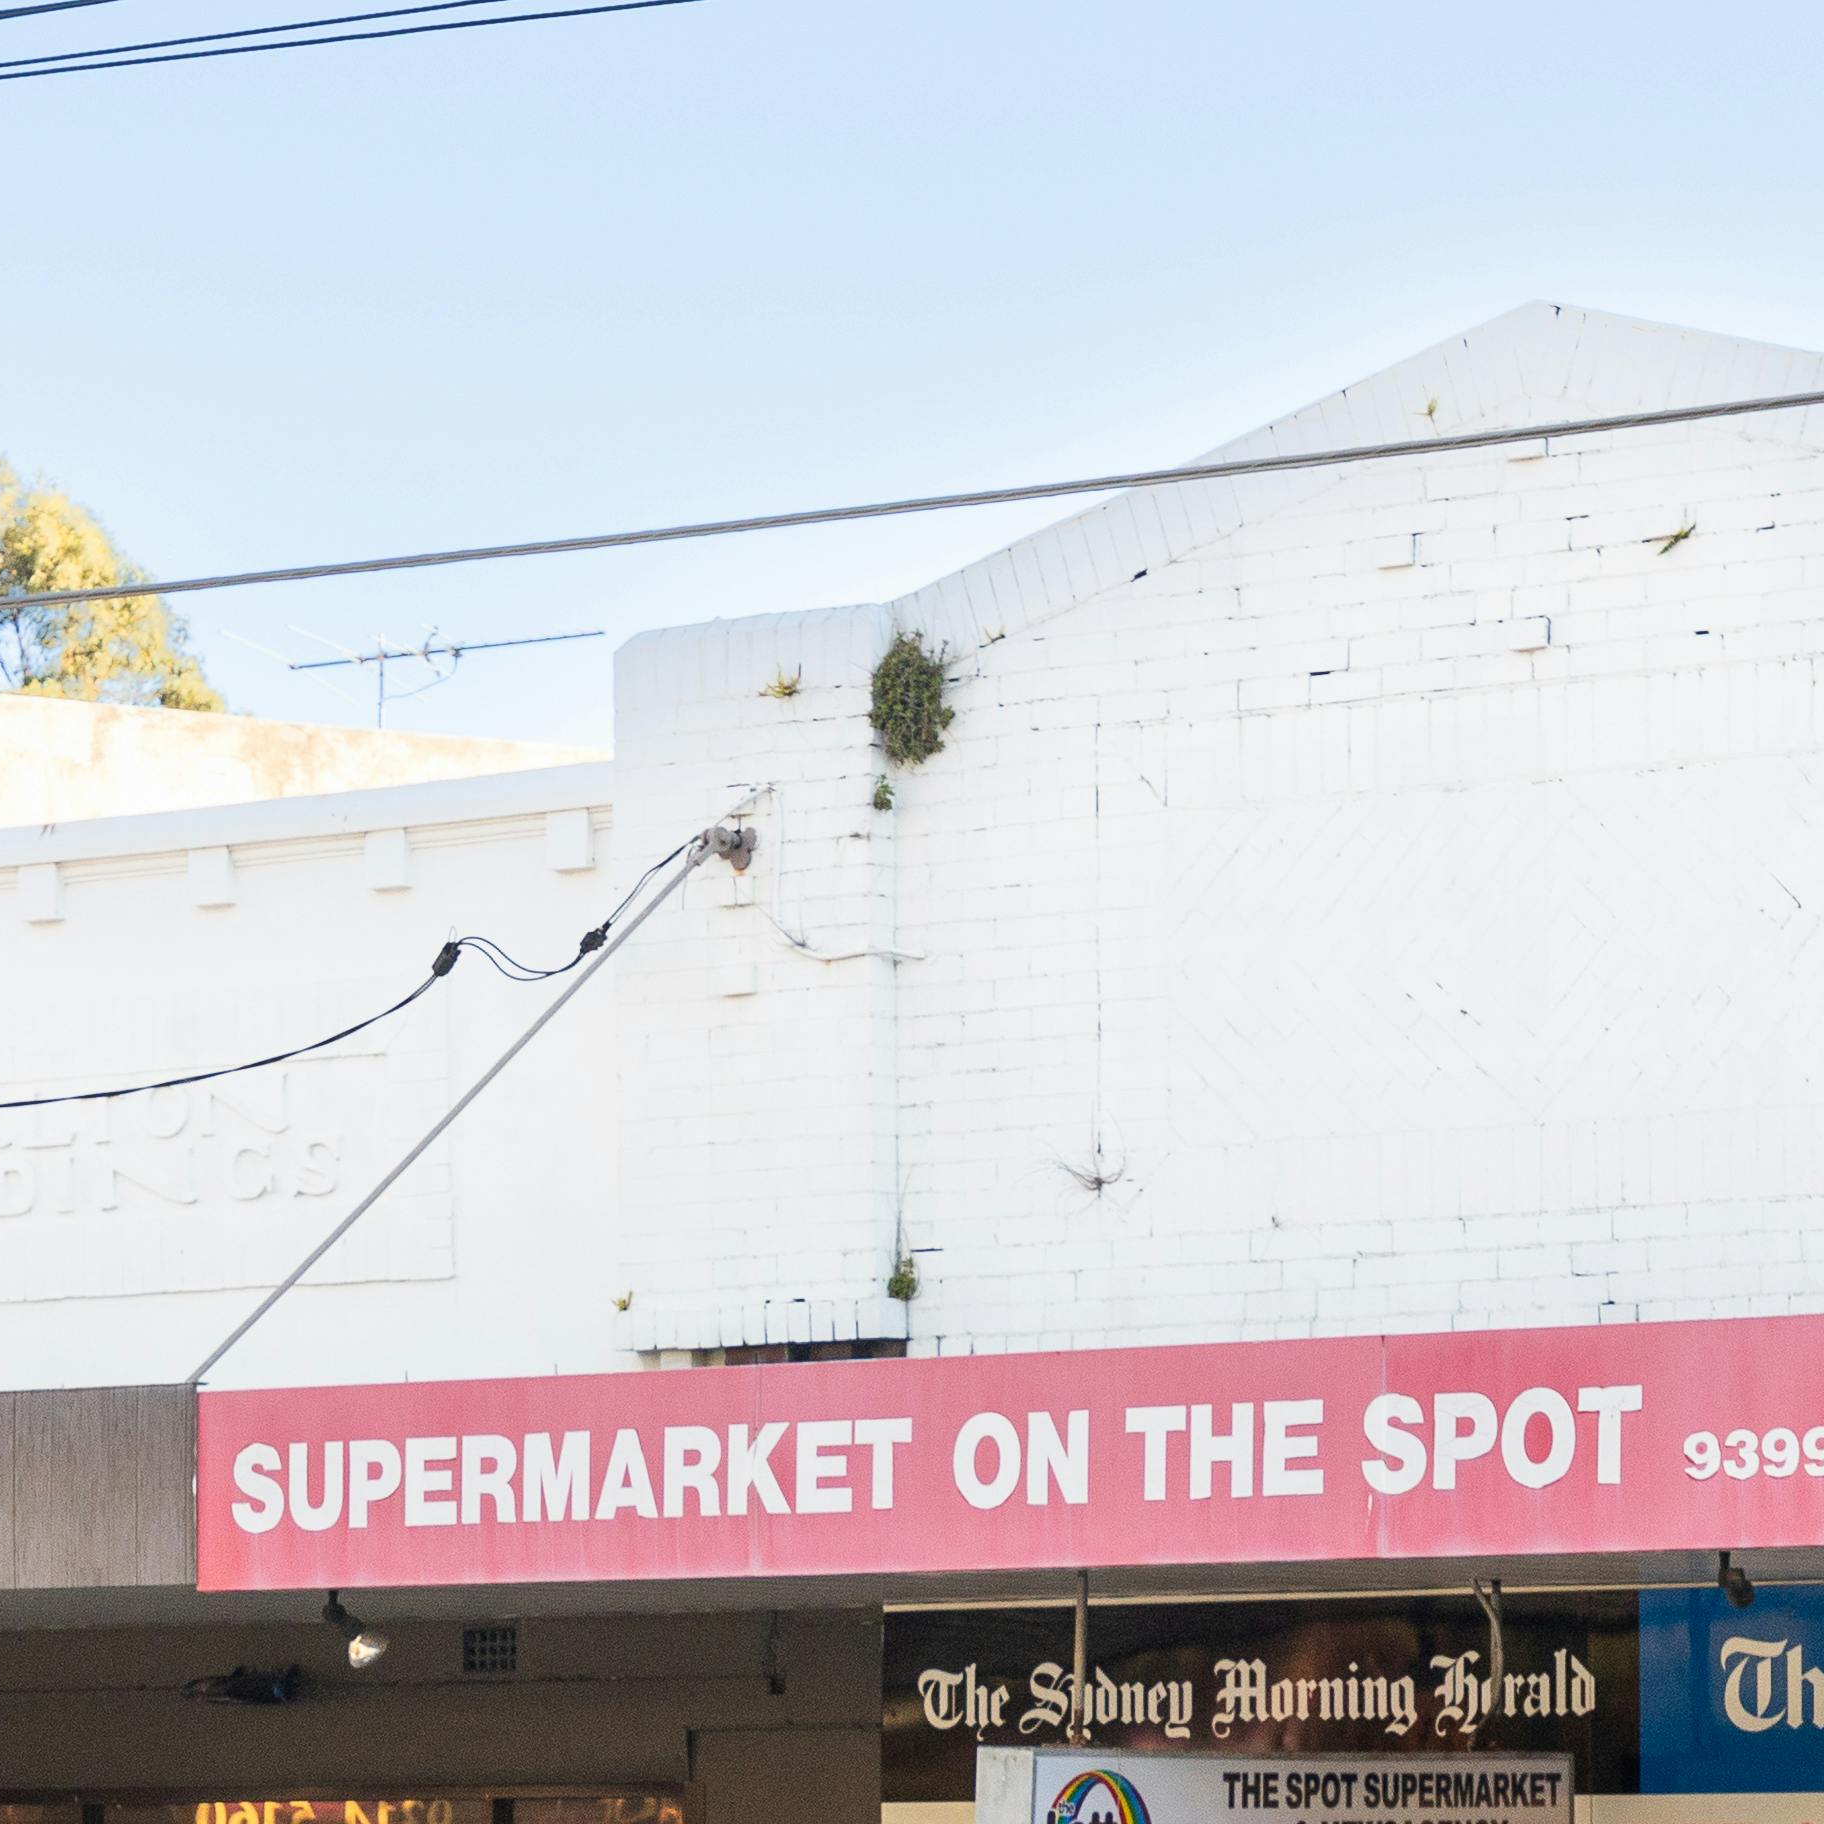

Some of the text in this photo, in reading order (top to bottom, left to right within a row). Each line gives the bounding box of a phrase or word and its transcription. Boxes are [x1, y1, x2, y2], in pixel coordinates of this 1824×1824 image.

[231, 1416, 914, 1535] SUPERMARKET
[952, 1409, 1090, 1510] ON
[1124, 1398, 1325, 1504] THE
[1361, 1383, 1644, 1496] SPOT
[917, 1662, 1012, 1744] The
[1211, 1658, 1418, 1737] Morning
[1057, 1801, 1076, 1816] the
[1222, 1771, 1563, 1811] THE SPOT SUPERMARKET
